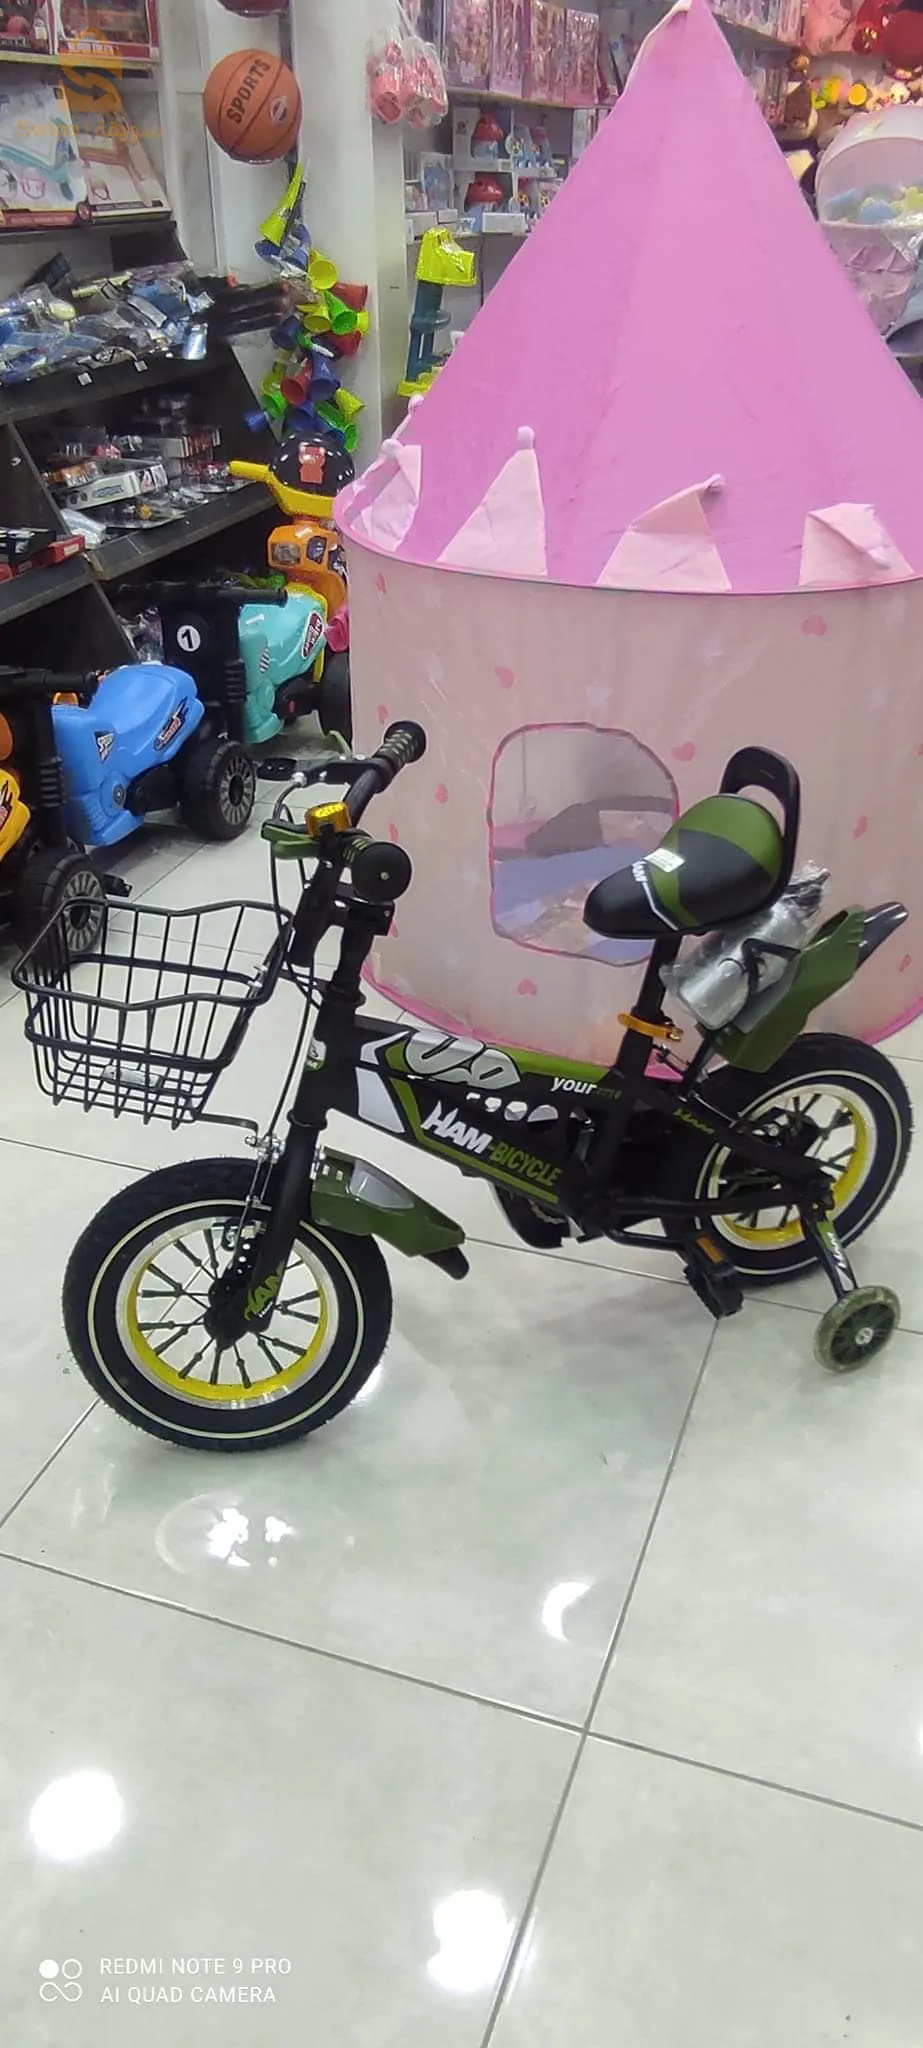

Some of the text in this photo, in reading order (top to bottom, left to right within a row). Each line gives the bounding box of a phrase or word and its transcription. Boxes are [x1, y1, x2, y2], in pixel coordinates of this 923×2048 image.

[226, 58, 271, 125] SPORTS
[181, 628, 194, 649] 1
[550, 1077, 598, 1095] your
